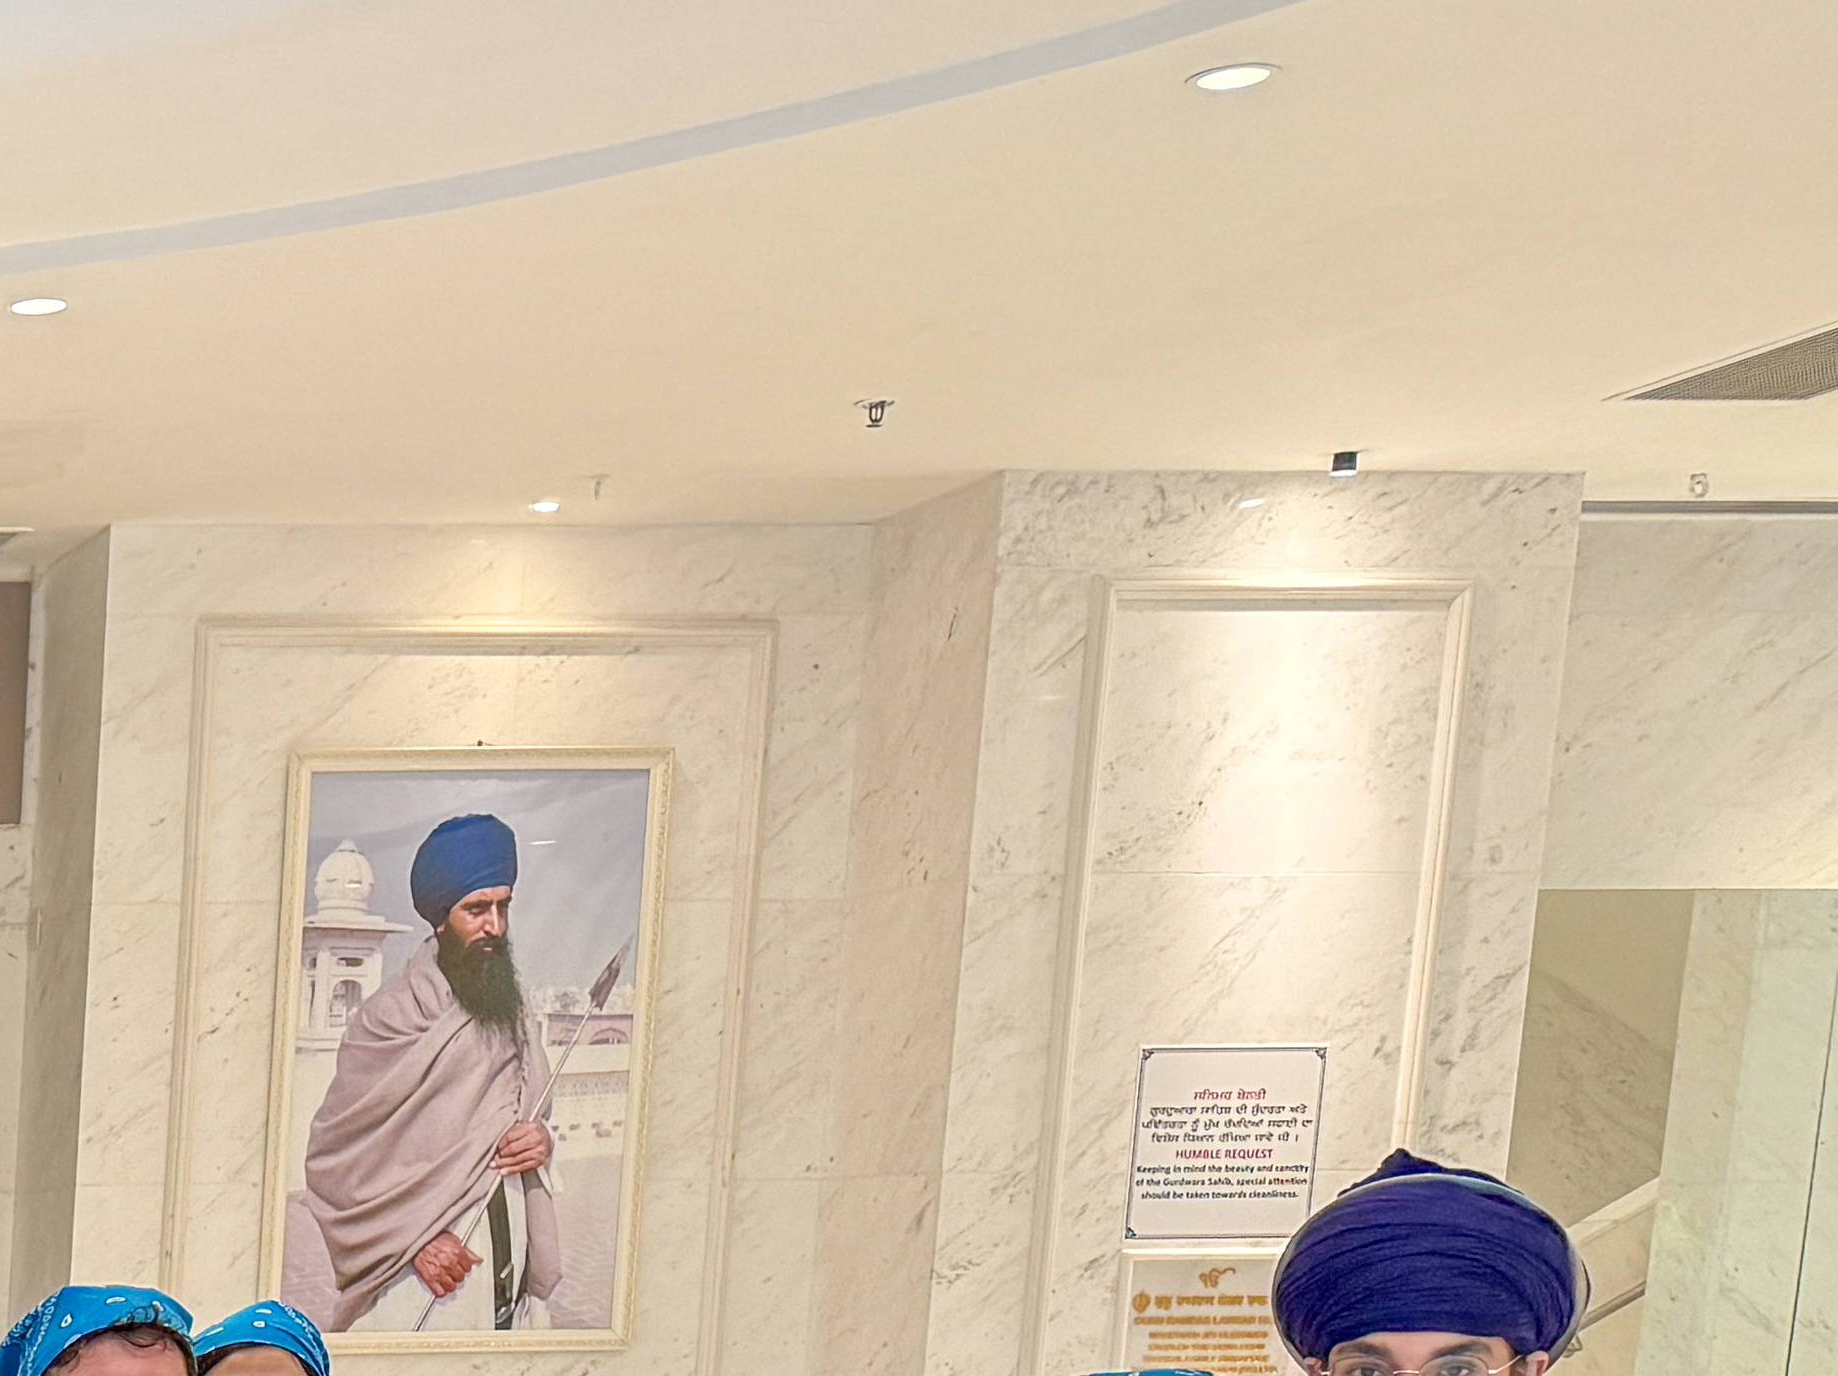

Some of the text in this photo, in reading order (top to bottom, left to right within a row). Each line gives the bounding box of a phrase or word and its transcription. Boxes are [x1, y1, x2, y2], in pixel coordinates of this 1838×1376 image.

[1176, 1149, 1274, 1160] HUMBLE REQUEST
[1136, 1165, 1171, 1175] Keeping
[1183, 1165, 1206, 1173] mind
[1208, 1164, 1222, 1173] the
[1257, 1164, 1273, 1172] and
[1141, 1191, 1171, 1200] should
[1173, 1191, 1184, 1199] be
[1186, 1191, 1210, 1199] taken
